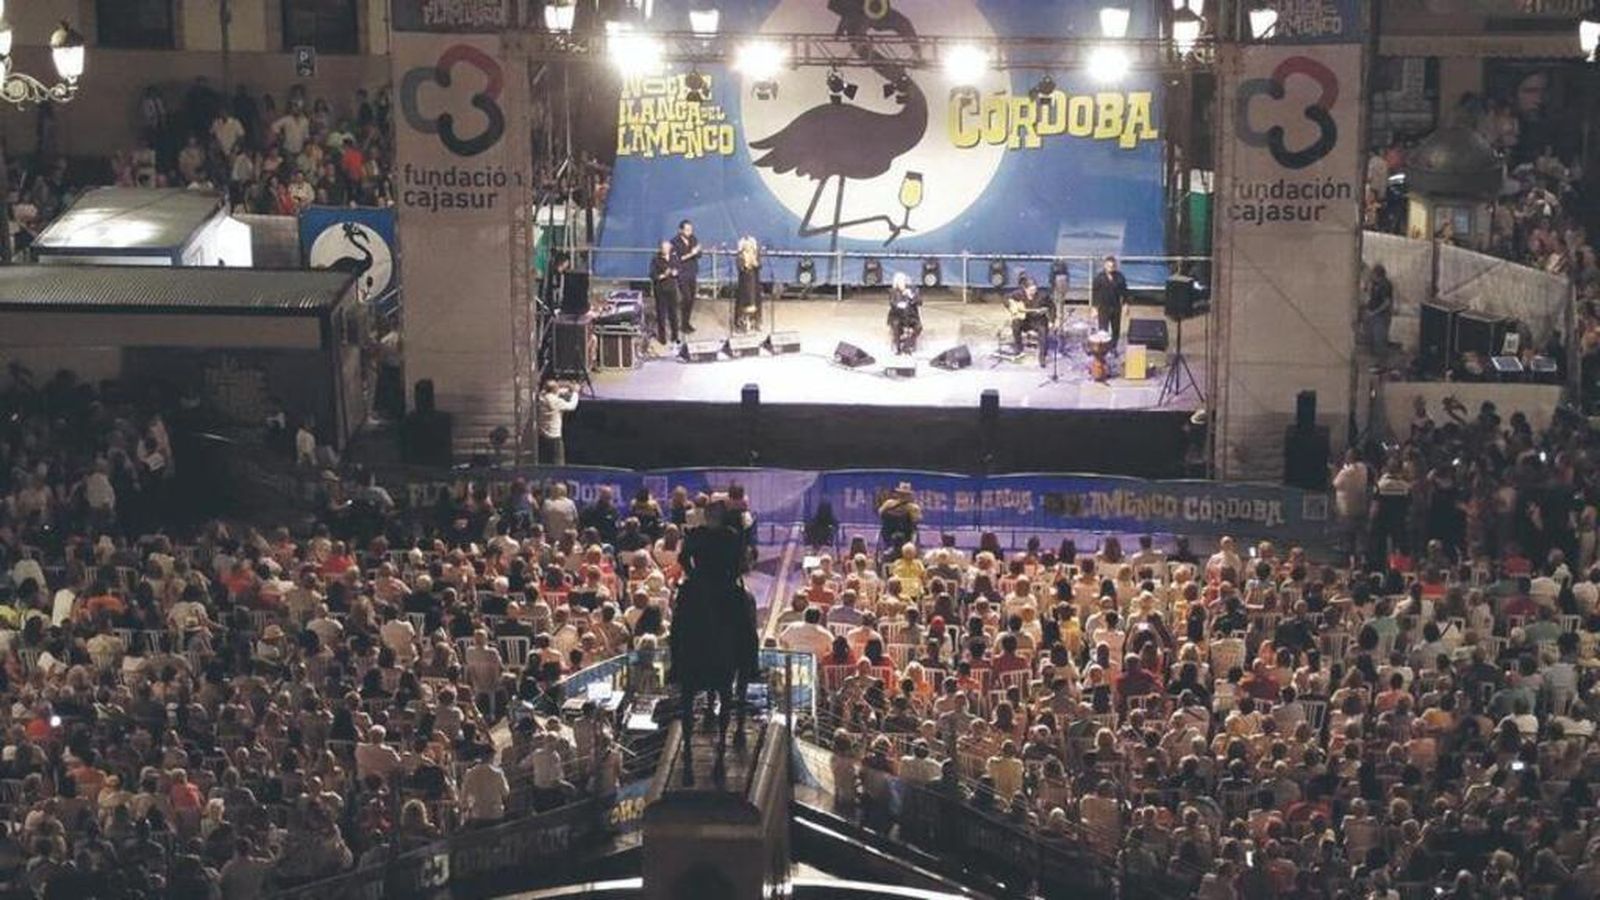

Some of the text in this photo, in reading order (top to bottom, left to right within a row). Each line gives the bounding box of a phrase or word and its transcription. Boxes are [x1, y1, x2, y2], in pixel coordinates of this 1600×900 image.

[949, 86, 1159, 149] CÓRDOBA
[404, 163, 522, 187] fundación
[403, 186, 499, 213] cajasur
